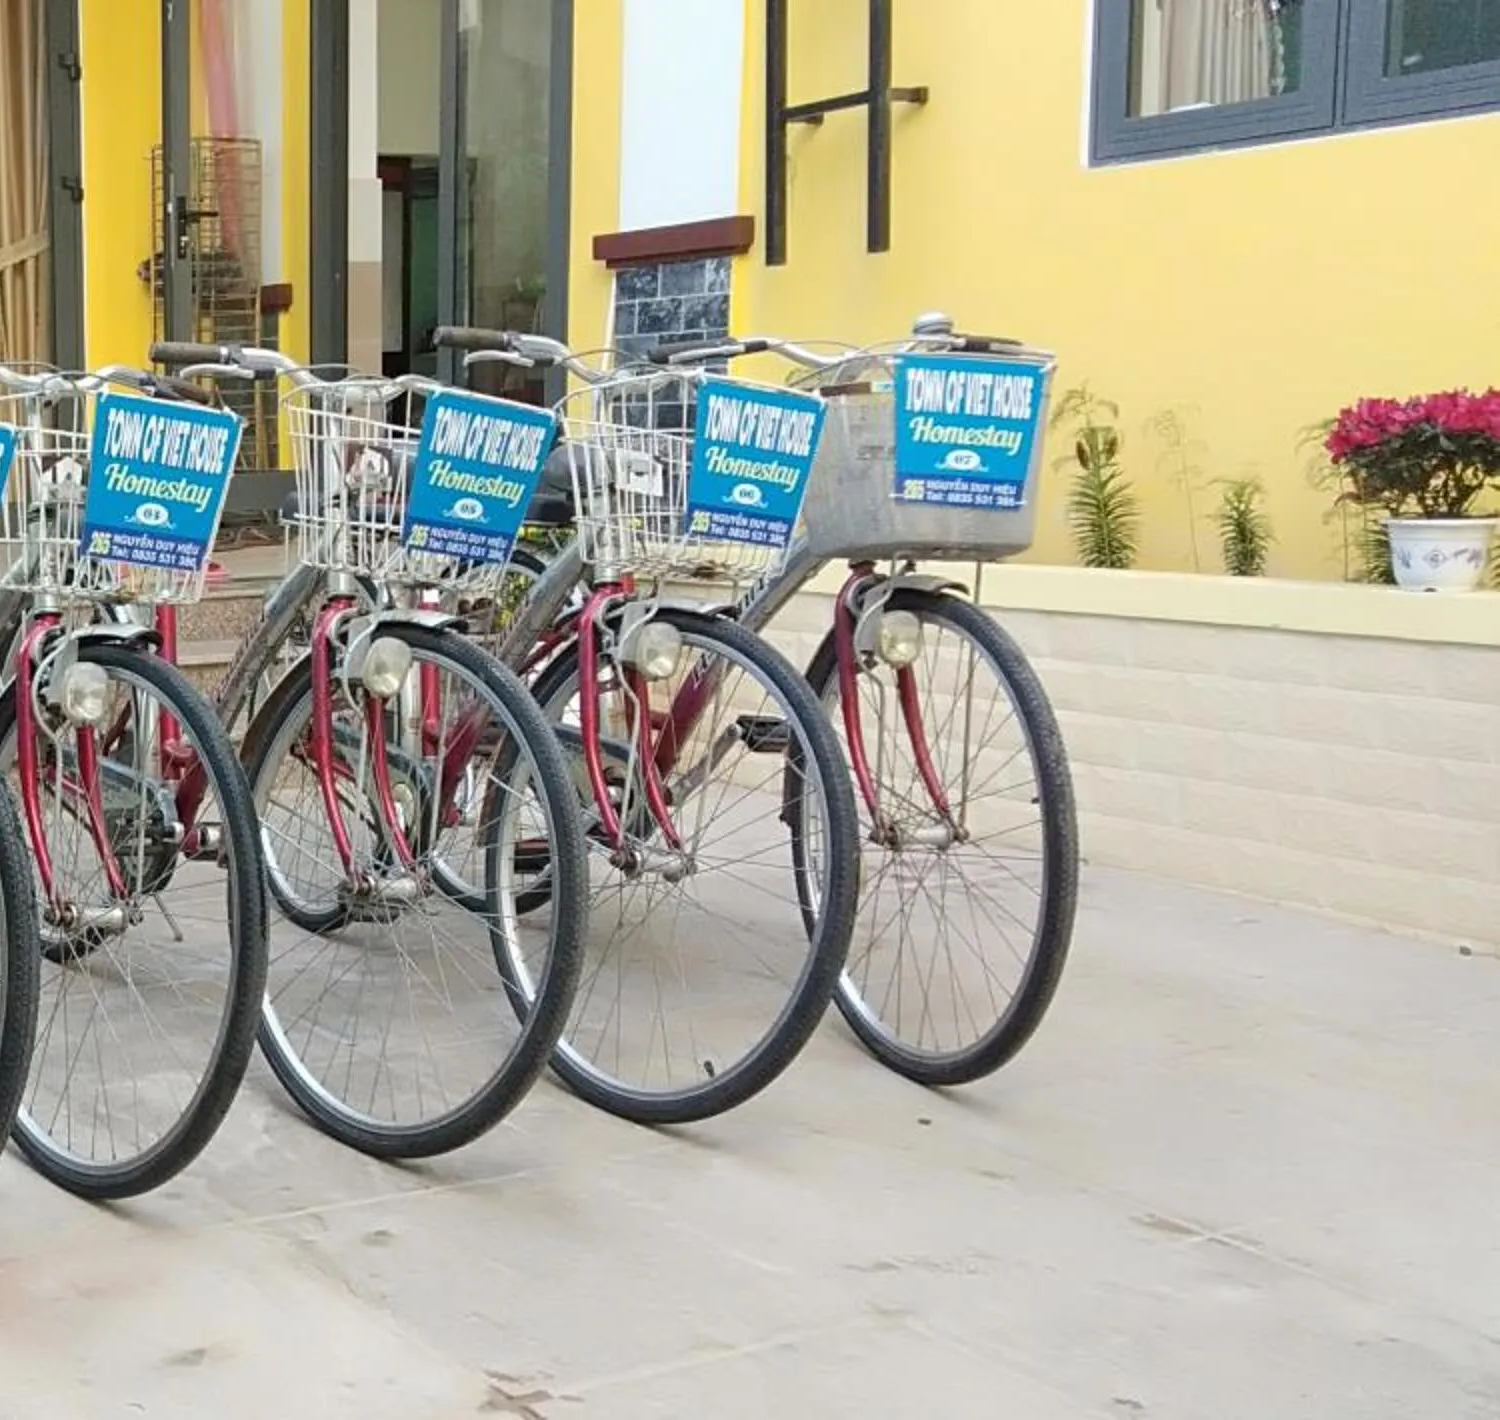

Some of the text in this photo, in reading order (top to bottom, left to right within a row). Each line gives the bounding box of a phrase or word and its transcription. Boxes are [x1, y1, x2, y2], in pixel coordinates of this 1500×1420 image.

[906, 368, 1034, 420] TOWN OF VIET HOUSE
[104, 407, 229, 475] TOWN OF VIET HOUSE
[429, 406, 546, 472] TOWN OF VIET HOUSE
[705, 395, 816, 457] TOWN OF VIET HOUSE
[909, 415, 1023, 456] Homestay
[104, 462, 213, 513] Homestay
[427, 459, 526, 509] Homestay
[705, 446, 801, 493] Homestay
